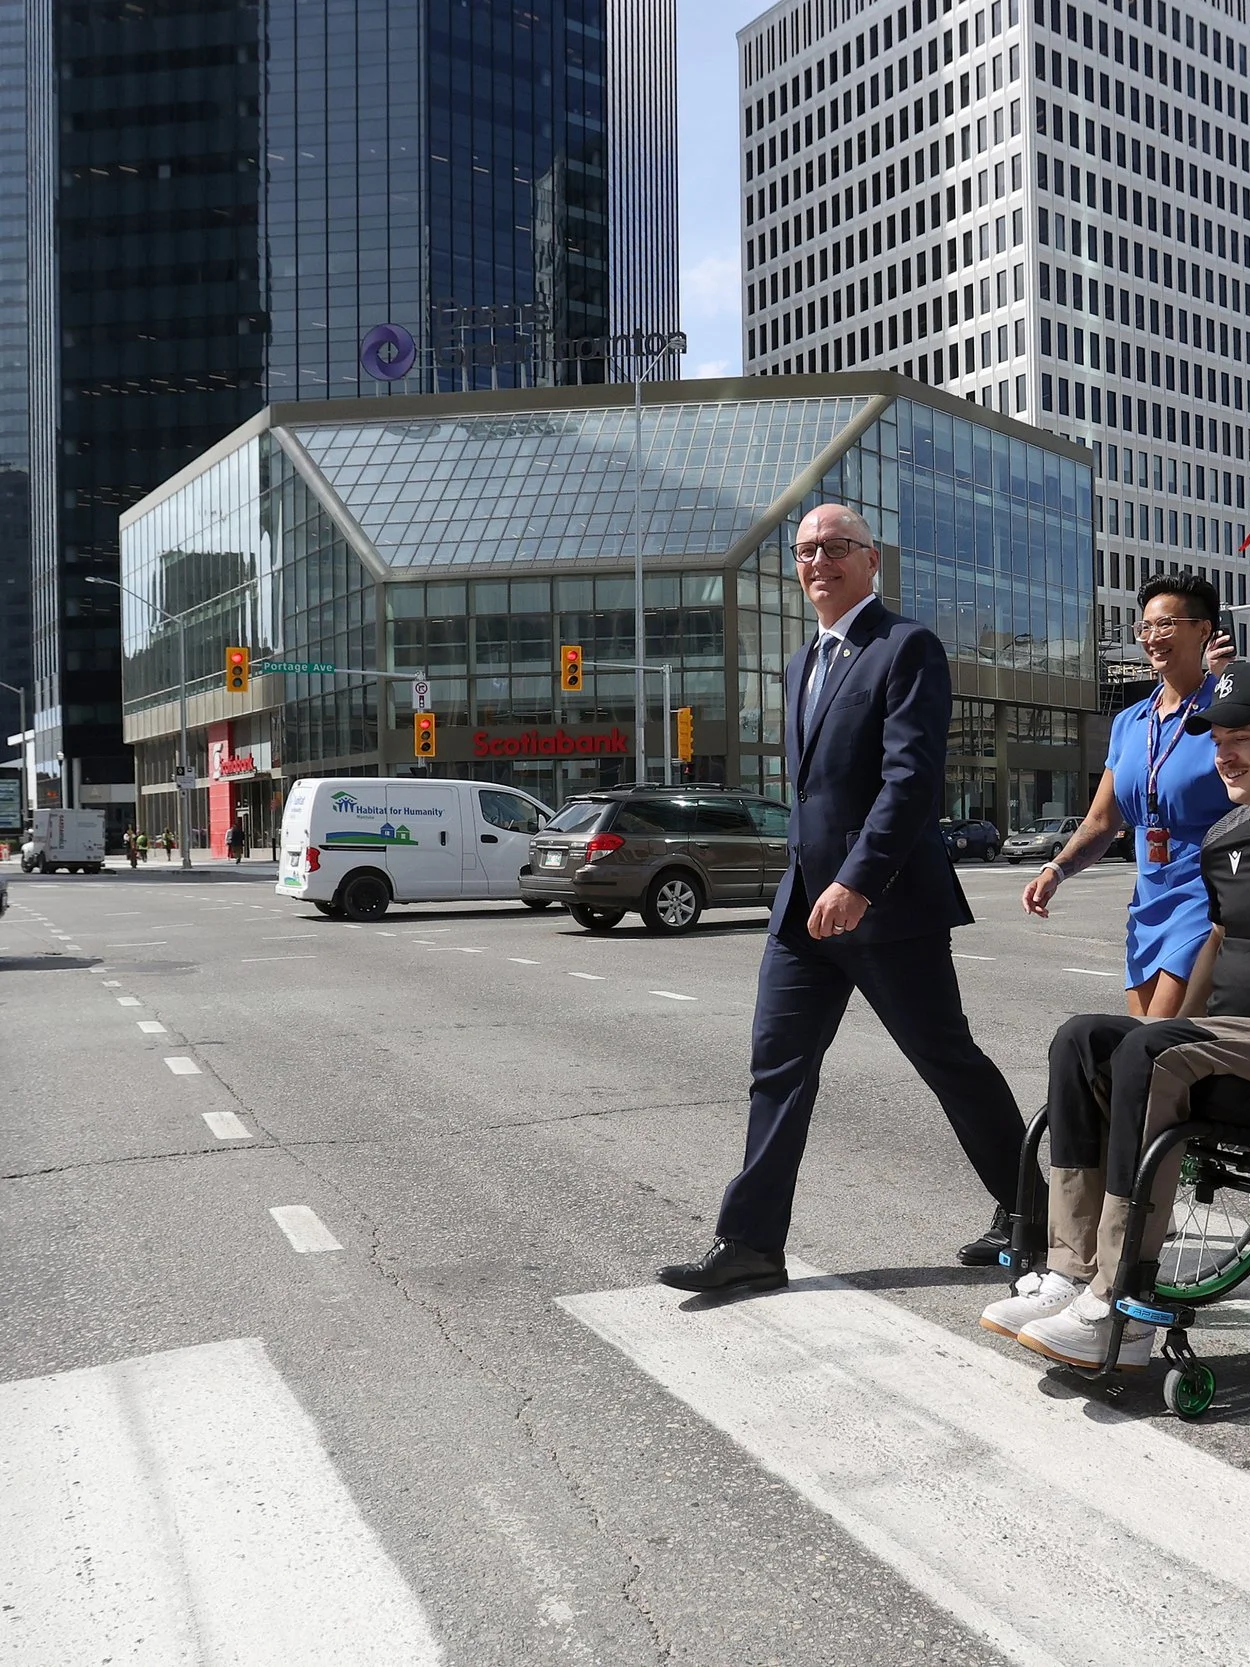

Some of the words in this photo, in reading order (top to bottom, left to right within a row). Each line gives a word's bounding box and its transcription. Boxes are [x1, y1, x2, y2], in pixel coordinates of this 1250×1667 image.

[531, 327, 687, 362] Thornton
[264, 662, 308, 673] Portage
[472, 727, 628, 757] Scotiabank
[356, 805, 387, 815] Habitat
[390, 806, 402, 815] for
[403, 807, 443, 818] Humanity
